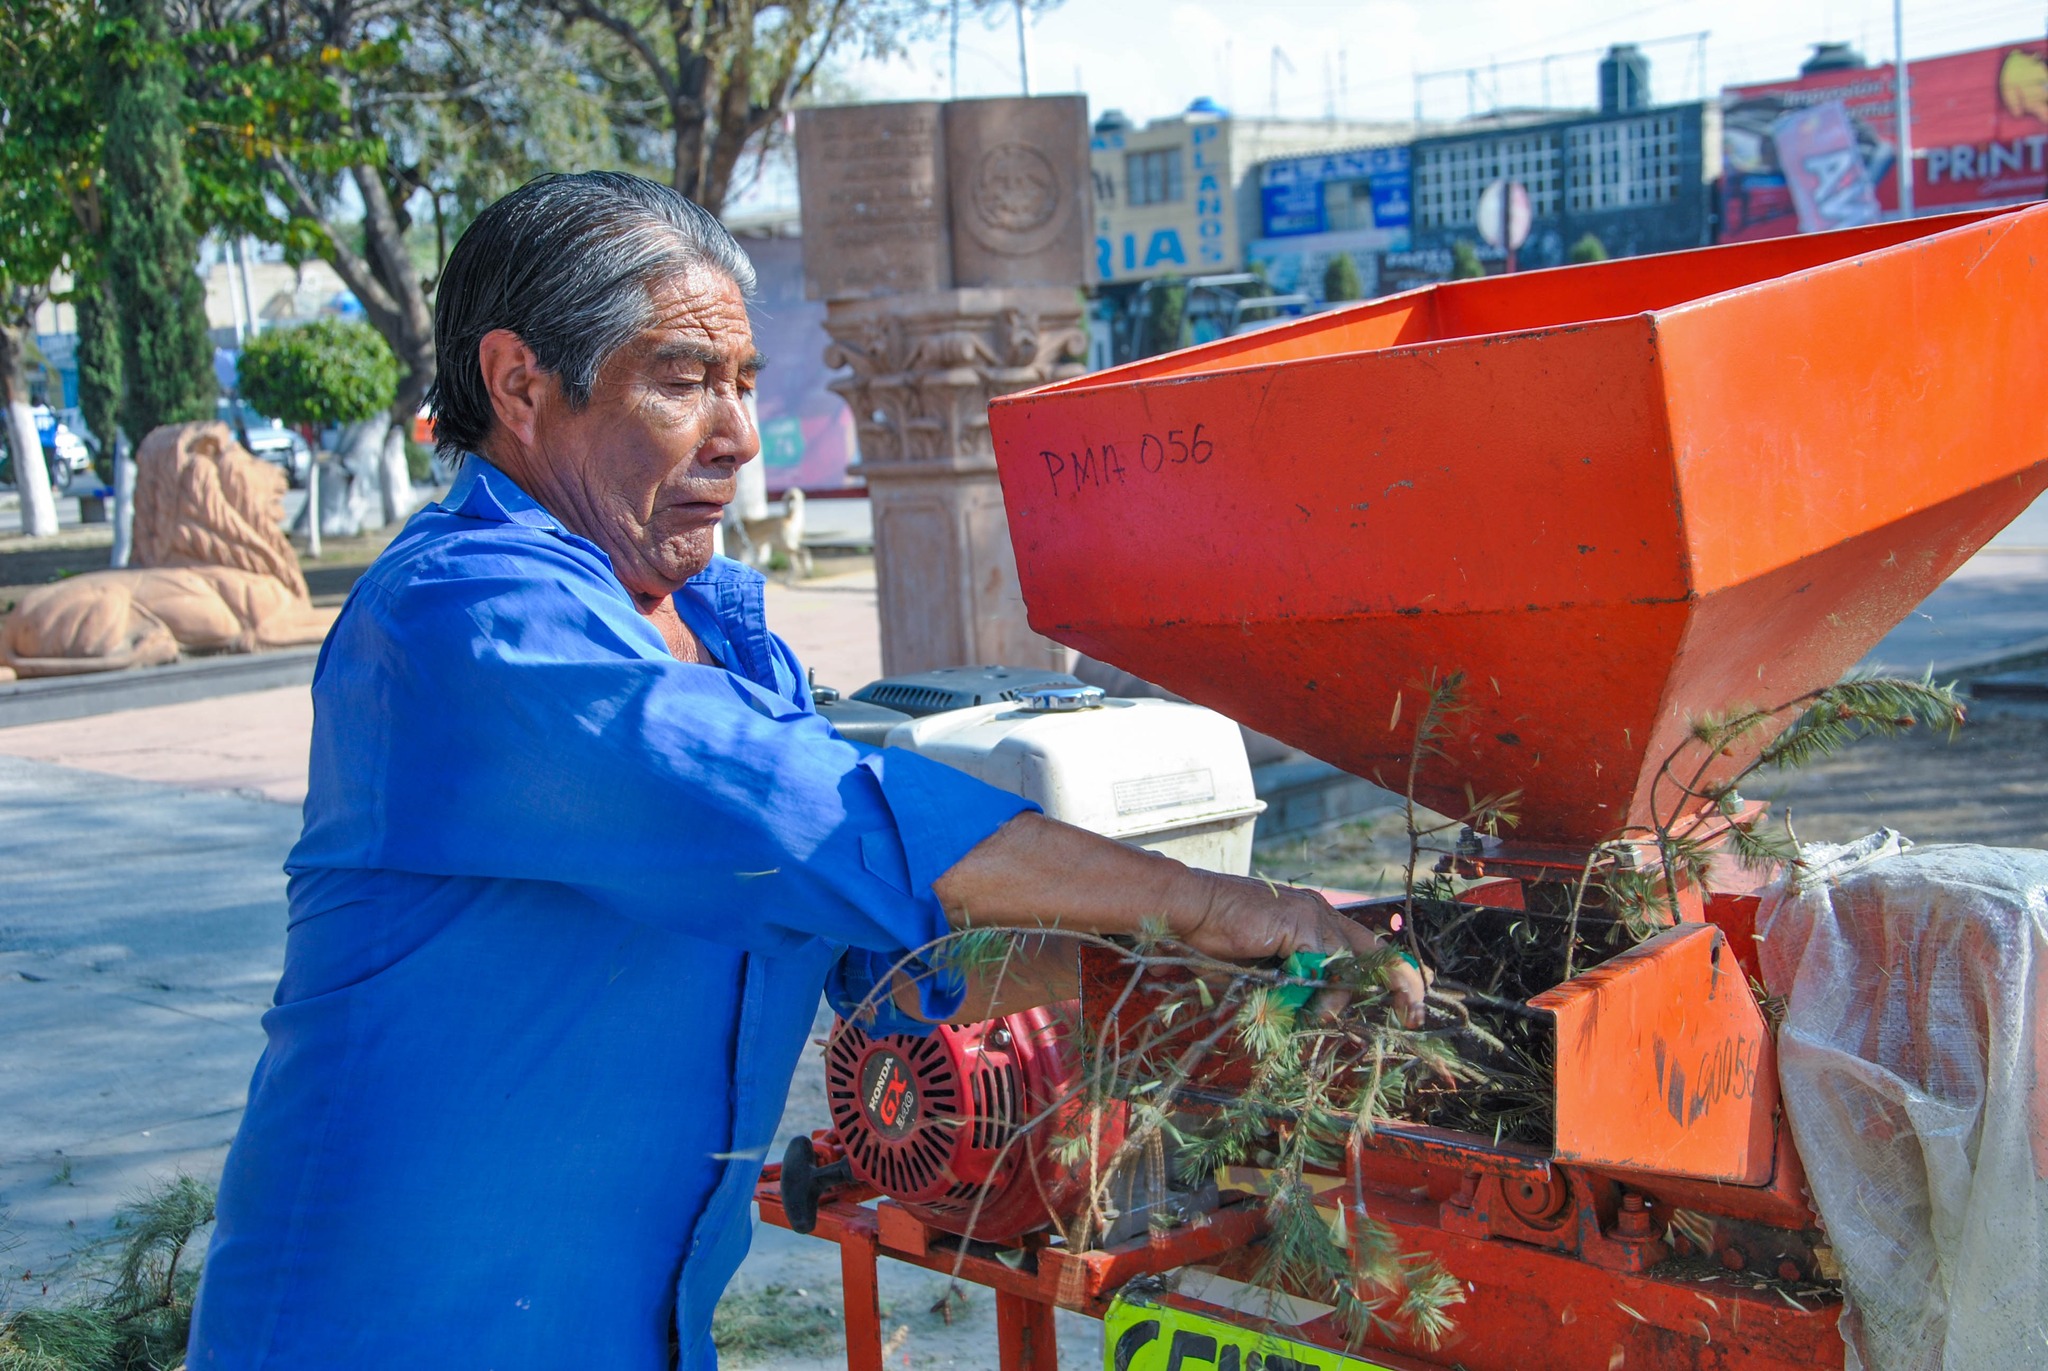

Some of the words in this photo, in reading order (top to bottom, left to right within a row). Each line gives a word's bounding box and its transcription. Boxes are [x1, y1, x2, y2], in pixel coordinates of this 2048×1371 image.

[1140, 423, 1213, 474] 056
[868, 1057, 894, 1112] HONDA
[880, 1066, 908, 1126] GX
